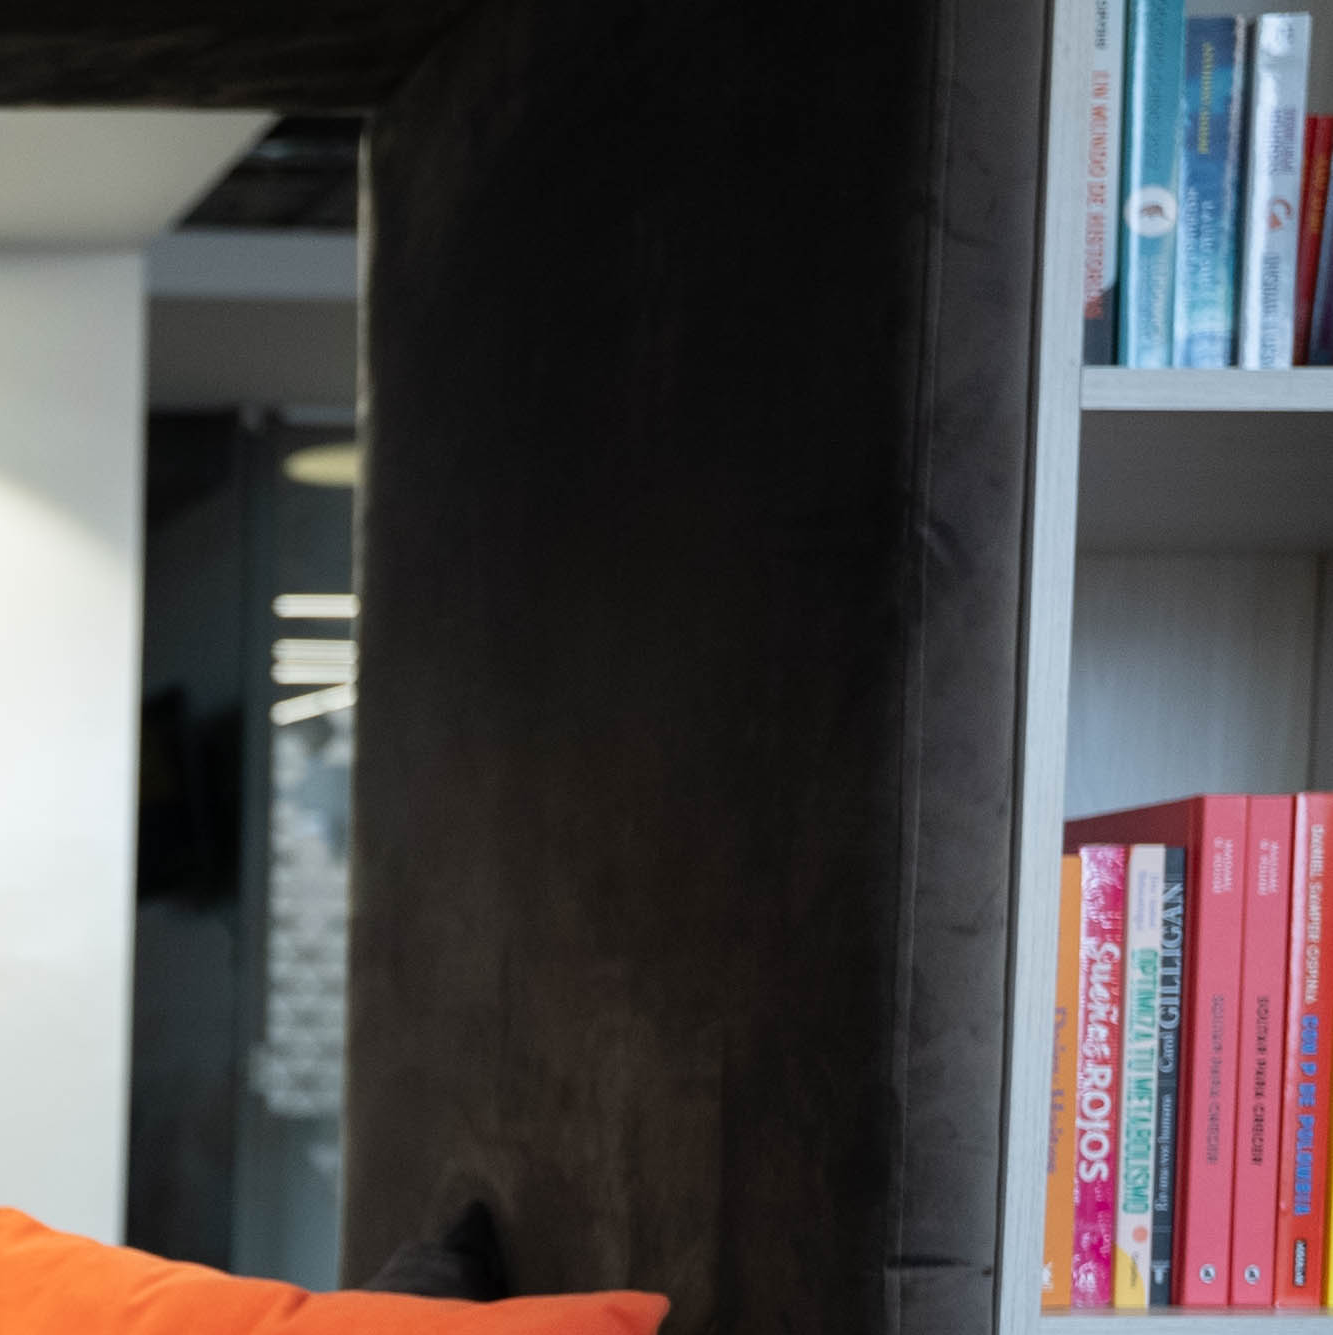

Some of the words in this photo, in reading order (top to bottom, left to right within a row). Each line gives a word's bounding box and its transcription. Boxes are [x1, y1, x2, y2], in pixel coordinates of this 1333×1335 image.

[1130, 948, 1158, 1043] OPTIMIZA
[1158, 881, 1185, 1032] GILLIGAN
[1127, 1044, 1155, 1074] TU
[1077, 1064, 1114, 1184] ROJOS
[1121, 1074, 1153, 1214] METABOLISMO
